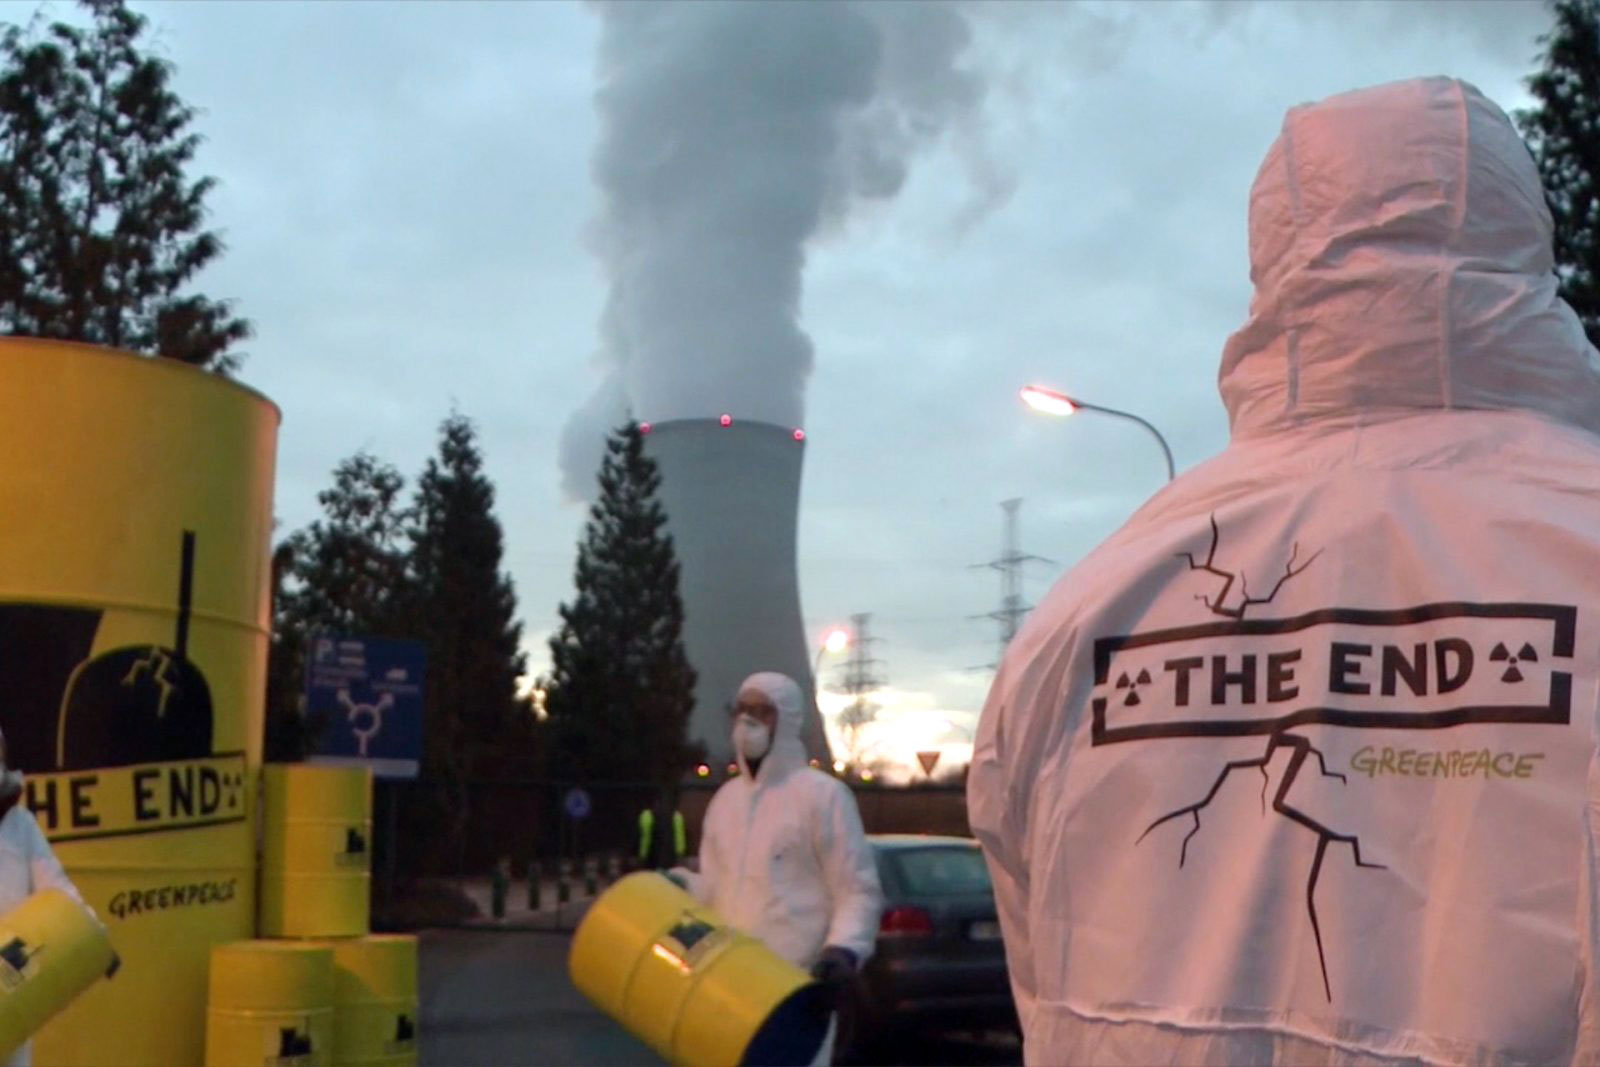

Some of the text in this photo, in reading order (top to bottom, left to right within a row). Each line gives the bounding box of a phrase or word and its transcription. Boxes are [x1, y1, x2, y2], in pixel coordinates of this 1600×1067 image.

[1164, 637, 1475, 707] THE END
[1351, 746, 1545, 779] GREENPEACE
[25, 765, 221, 829] HE END
[108, 878, 238, 920] GREENPEACE
